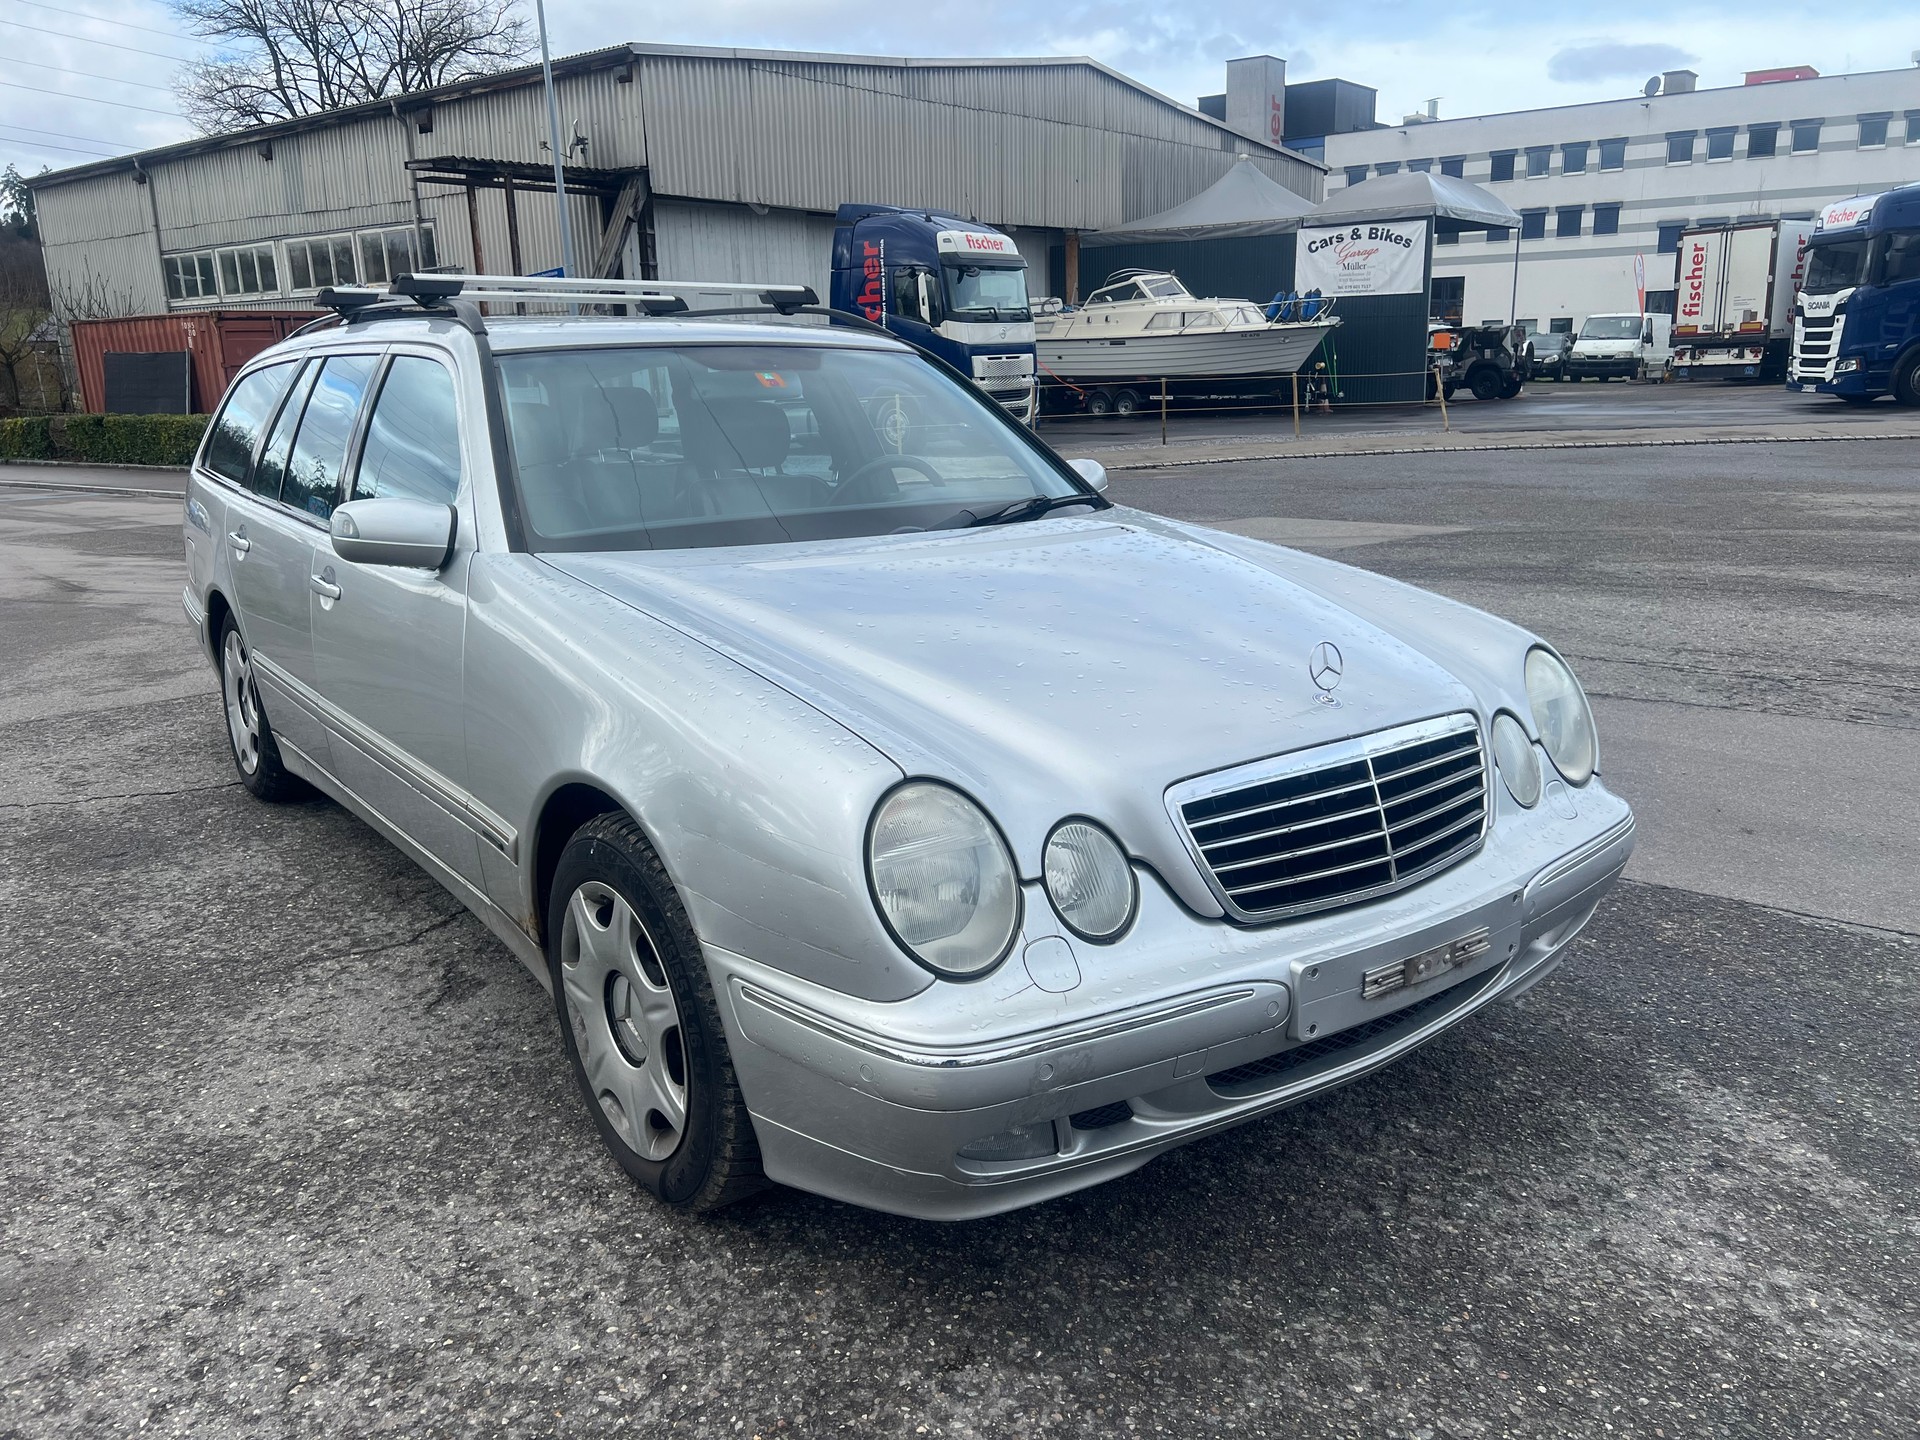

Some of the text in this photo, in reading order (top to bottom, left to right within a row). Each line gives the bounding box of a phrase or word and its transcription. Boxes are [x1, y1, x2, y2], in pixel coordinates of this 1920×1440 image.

[1826, 208, 1858, 224] fischer
[965, 234, 1004, 251] fischer
[1307, 227, 1413, 254] Cars & Bikes
[1333, 240, 1380, 265] Garage
[1342, 262, 1368, 271] Müller
[1682, 243, 1705, 317] fischer
[1807, 301, 1831, 311] SCANIA
